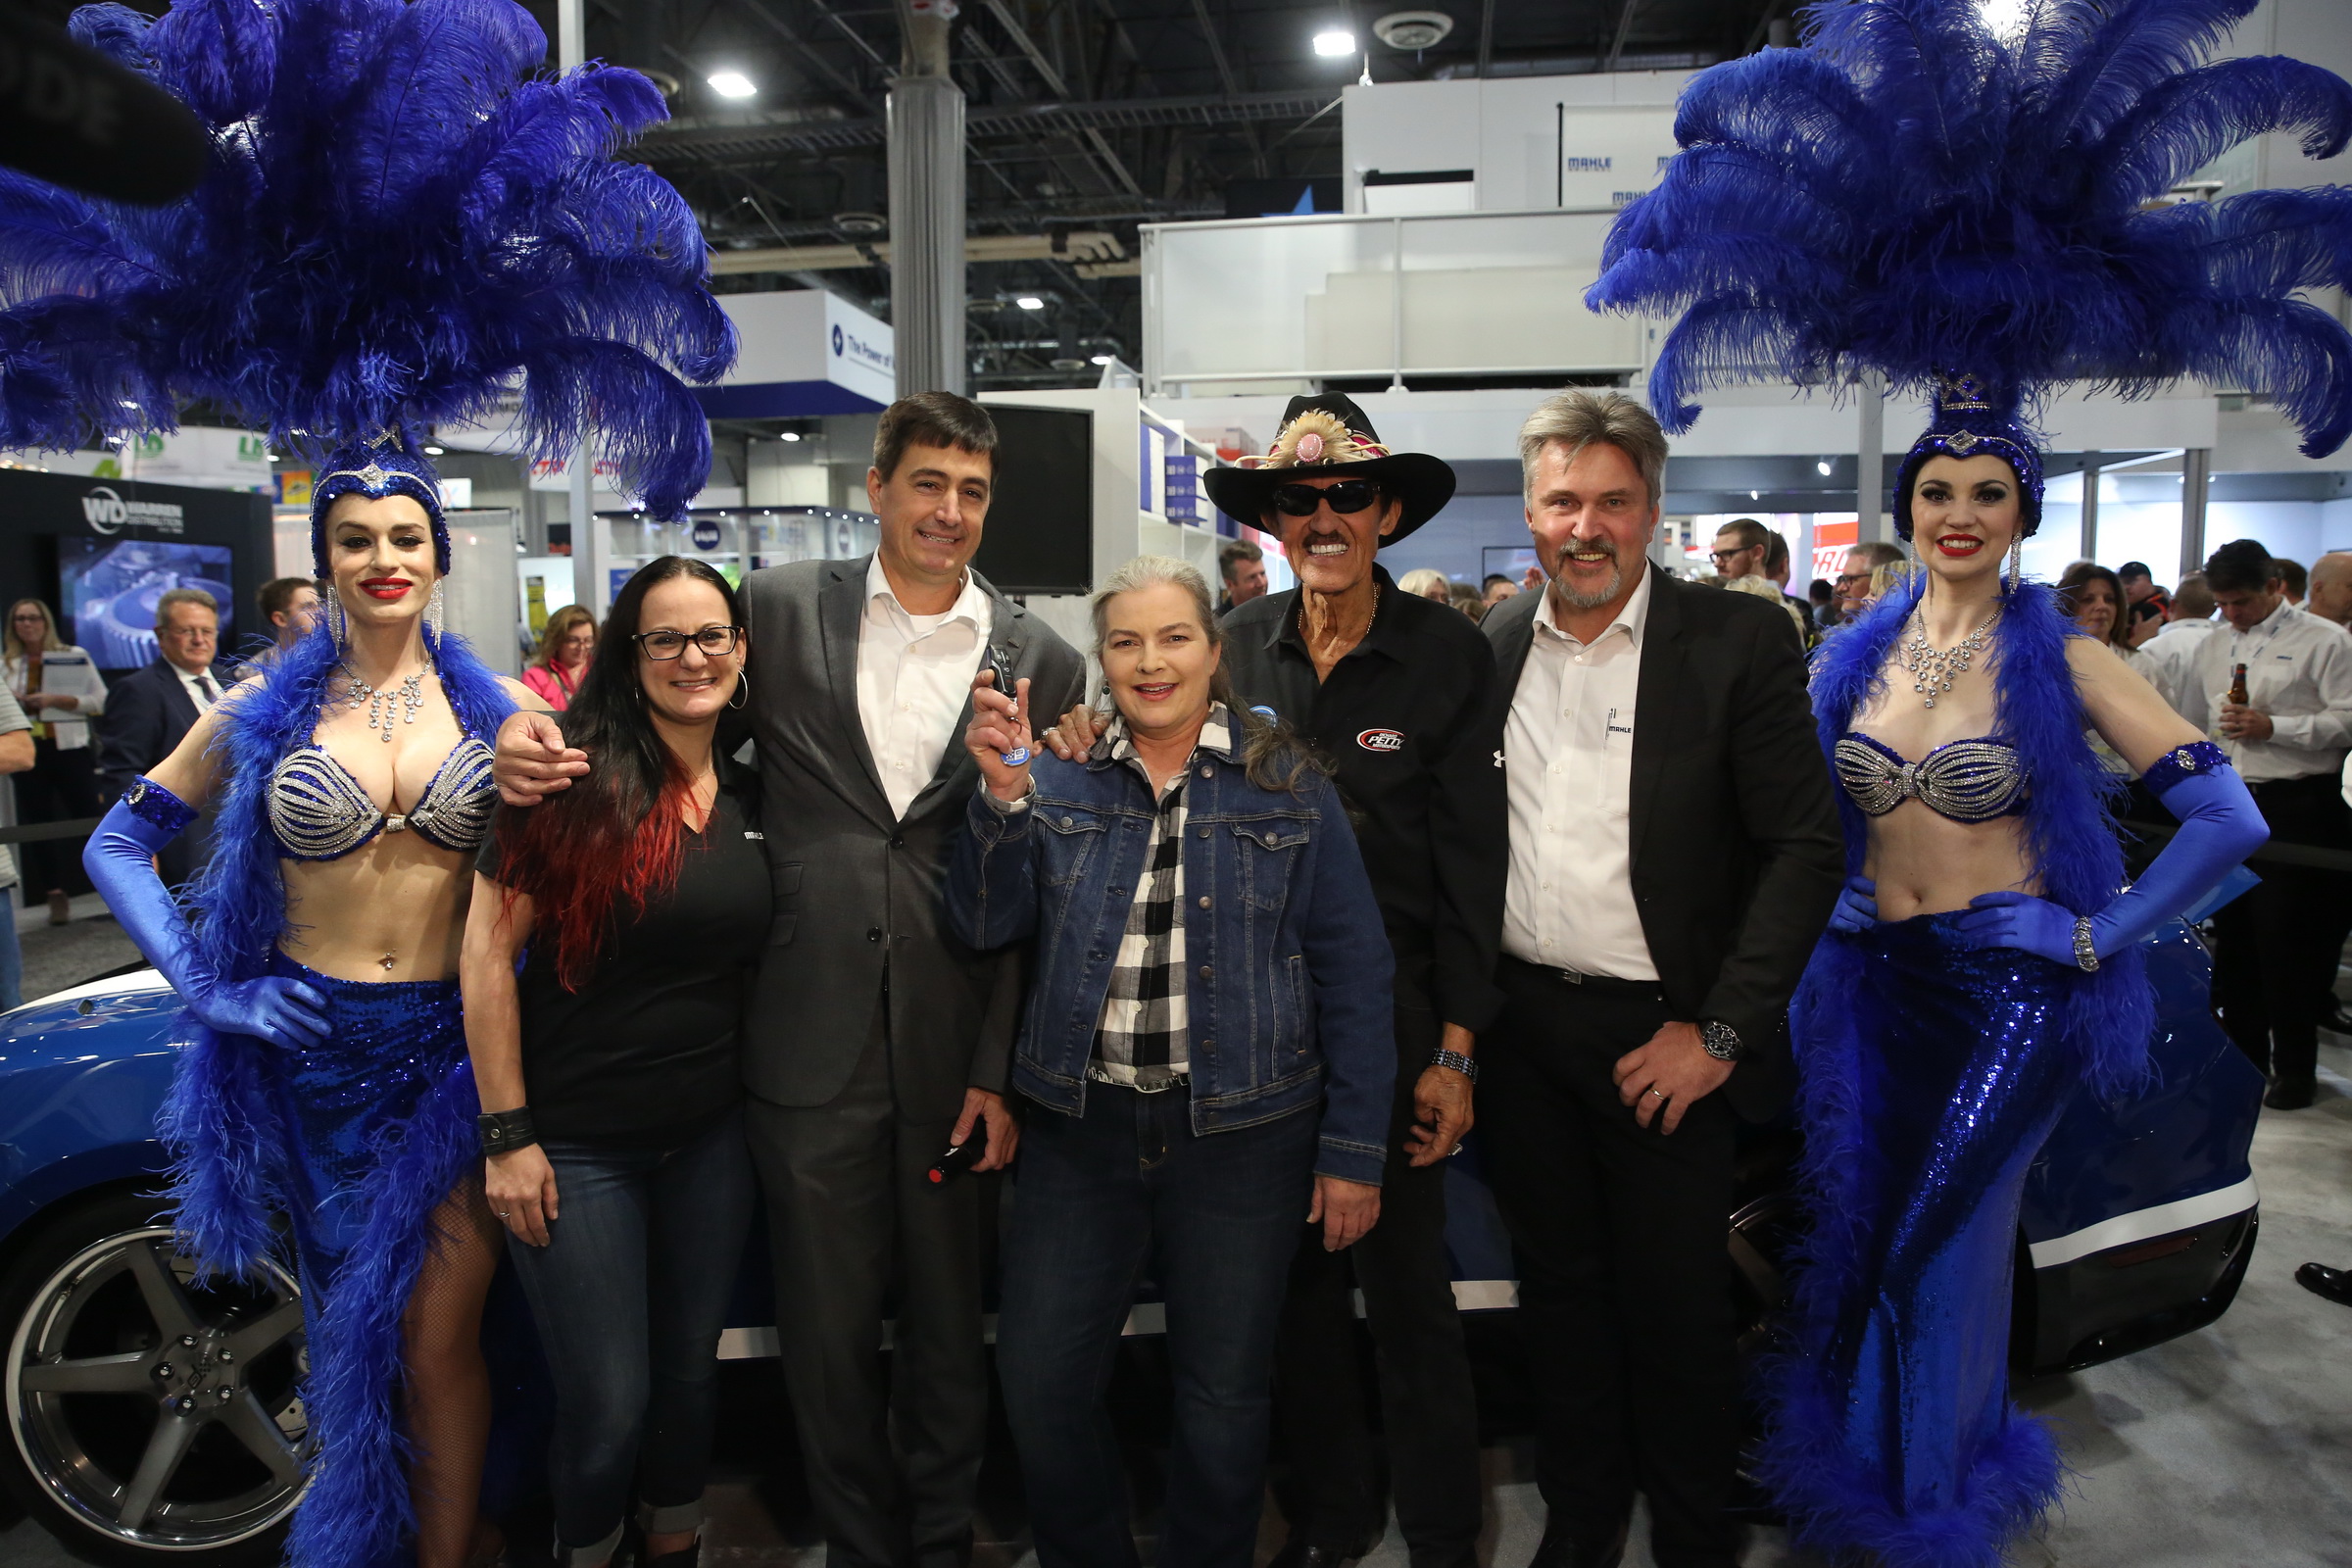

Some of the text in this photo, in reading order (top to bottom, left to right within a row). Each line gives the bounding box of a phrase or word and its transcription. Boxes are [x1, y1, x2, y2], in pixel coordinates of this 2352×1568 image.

[1568, 157, 1612, 169] MAHLE
[82, 496, 127, 524] WD
[1367, 735, 1405, 746] PETTY
